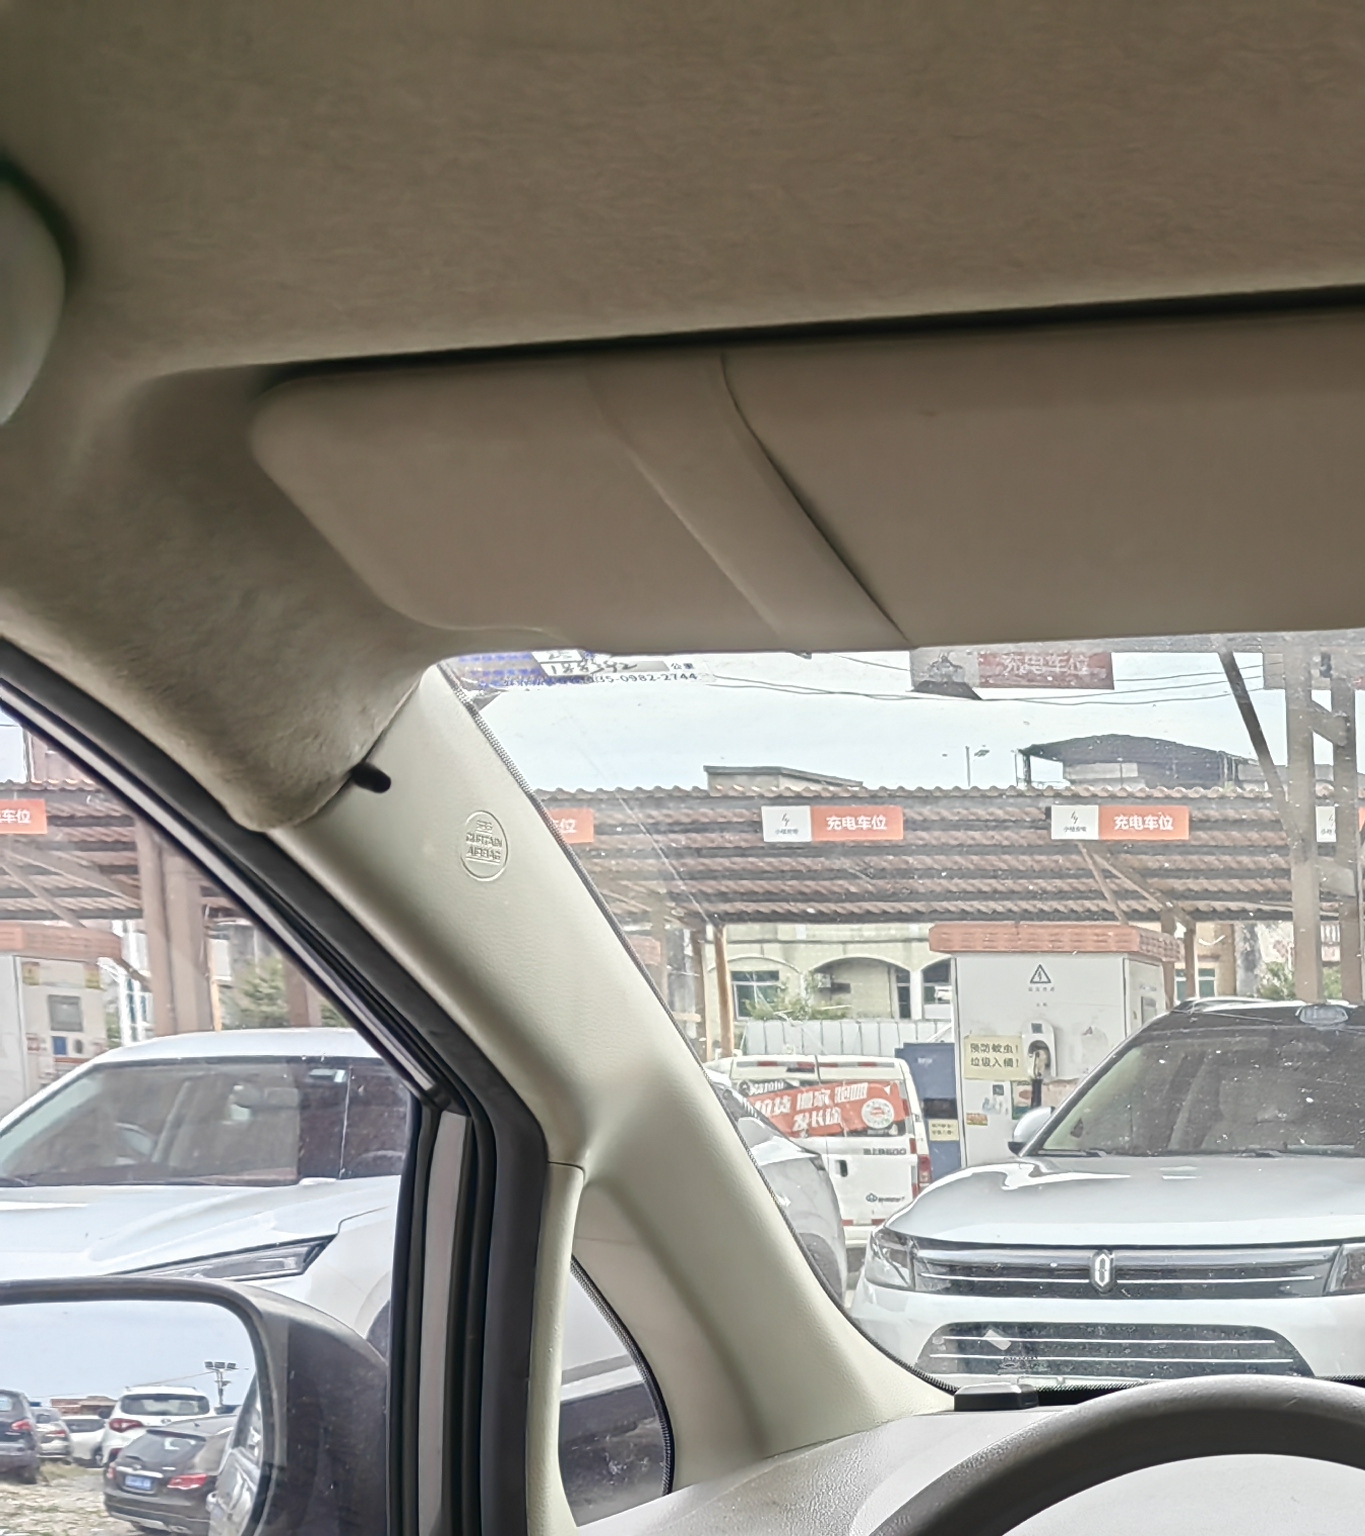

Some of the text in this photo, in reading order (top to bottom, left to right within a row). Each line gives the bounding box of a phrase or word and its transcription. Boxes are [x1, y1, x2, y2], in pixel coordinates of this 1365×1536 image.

[1001, 654, 1089, 676] 充电车位
[826, 815, 887, 831] 充电车位
[1114, 813, 1174, 831] 充电车位
